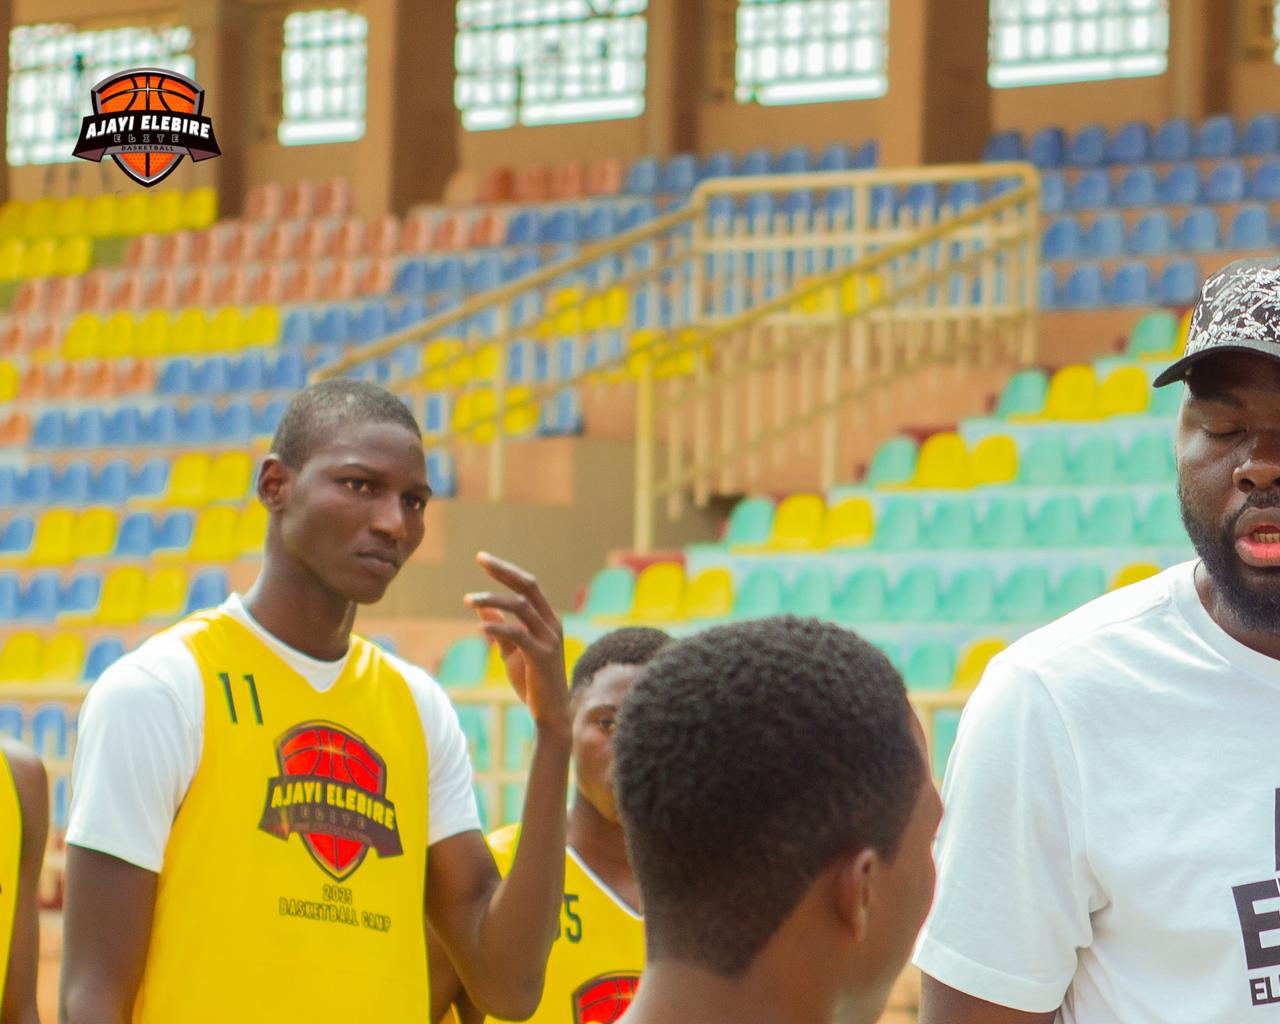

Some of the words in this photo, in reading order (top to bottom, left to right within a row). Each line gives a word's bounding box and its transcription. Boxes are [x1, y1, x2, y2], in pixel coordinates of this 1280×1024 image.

[218, 672, 263, 725] 11
[271, 781, 321, 808] AJAYI
[327, 784, 395, 830] ELEBIRE
[279, 898, 359, 926] BASKETBALL
[361, 911, 391, 933] CAMP
[322, 884, 352, 905] 2025
